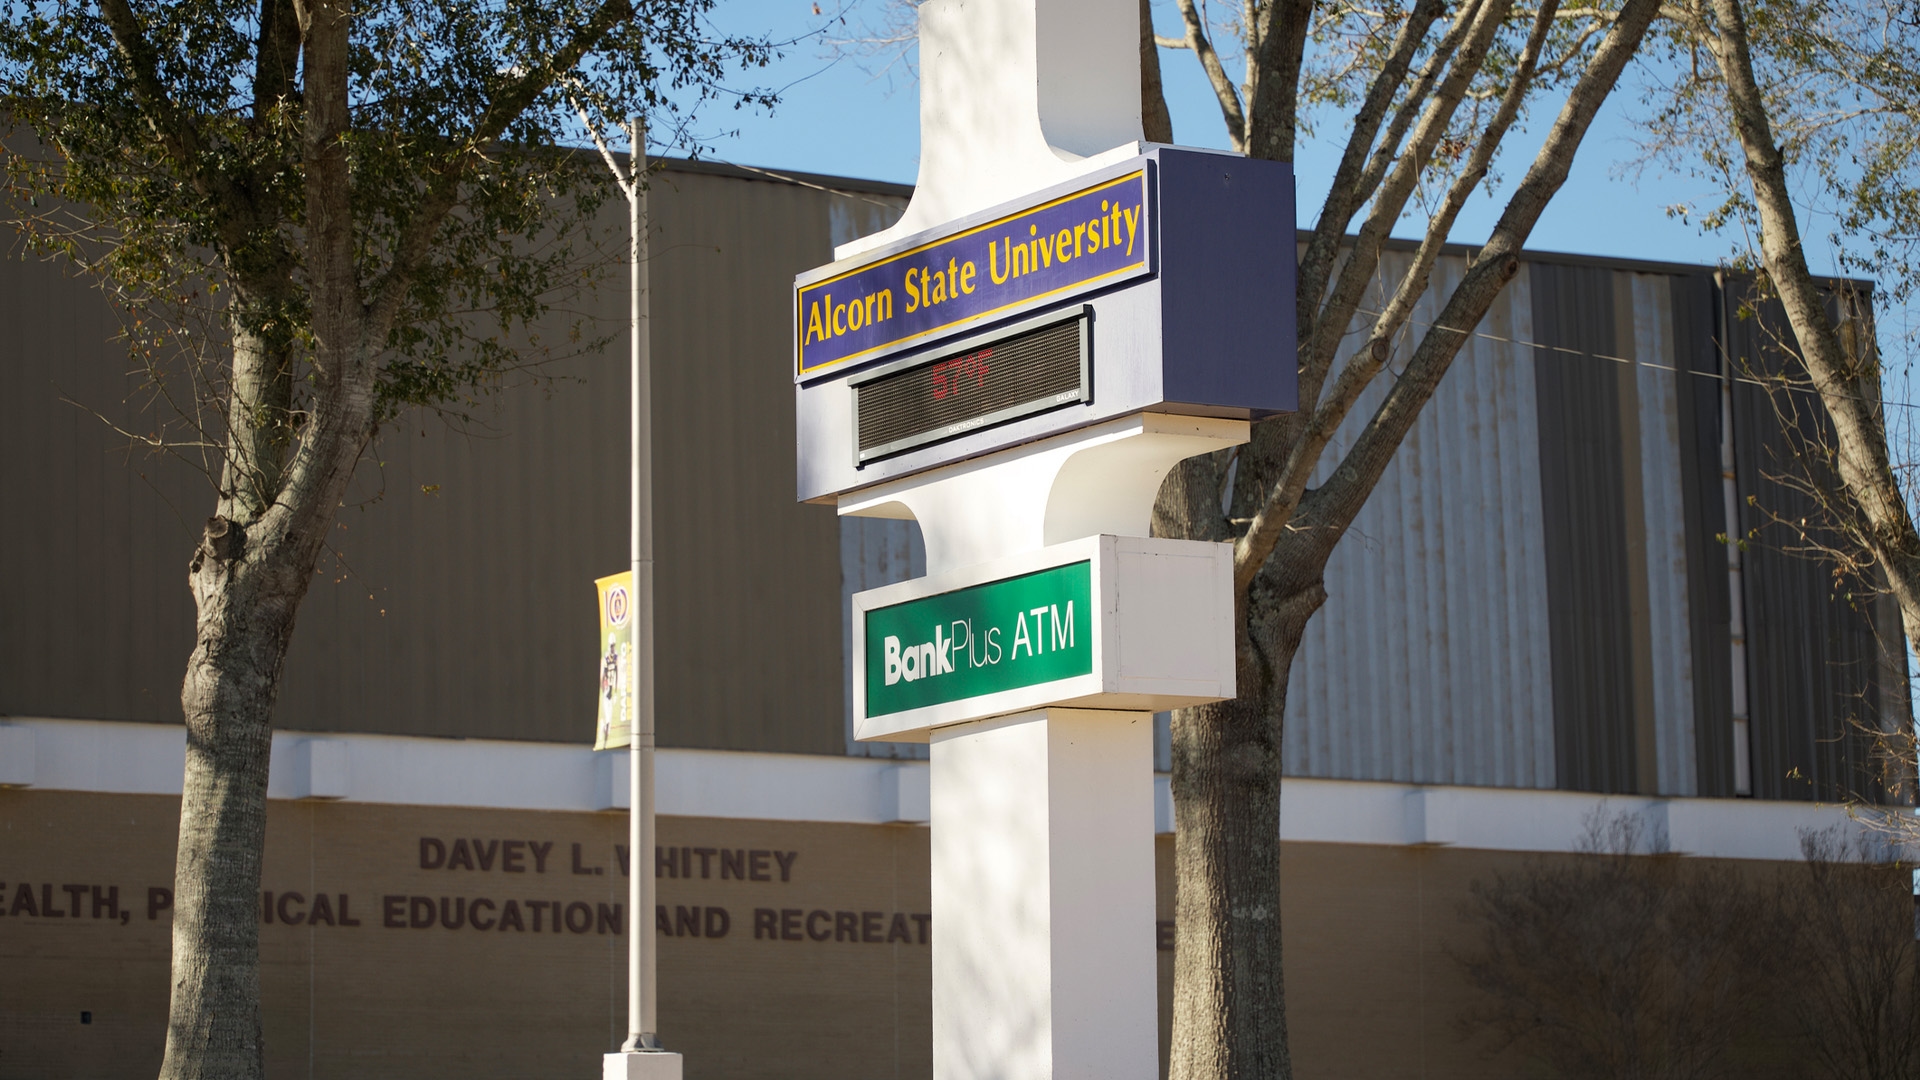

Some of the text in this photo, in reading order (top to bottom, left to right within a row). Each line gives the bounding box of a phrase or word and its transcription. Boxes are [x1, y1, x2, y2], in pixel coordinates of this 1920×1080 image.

[805, 198, 1141, 346] Alcorn State University
[1056, 390, 1079, 402] GALAXY
[948, 417, 985, 434] DAKTRONICS
[884, 599, 1075, 686] BankPlus ATM
[420, 836, 553, 874] DAVEY
[571, 842, 604, 876] L.
[0, 882, 130, 926] ALTH,
[148, 886, 361, 927] PICAL
[382, 895, 623, 936] EDUCATION
